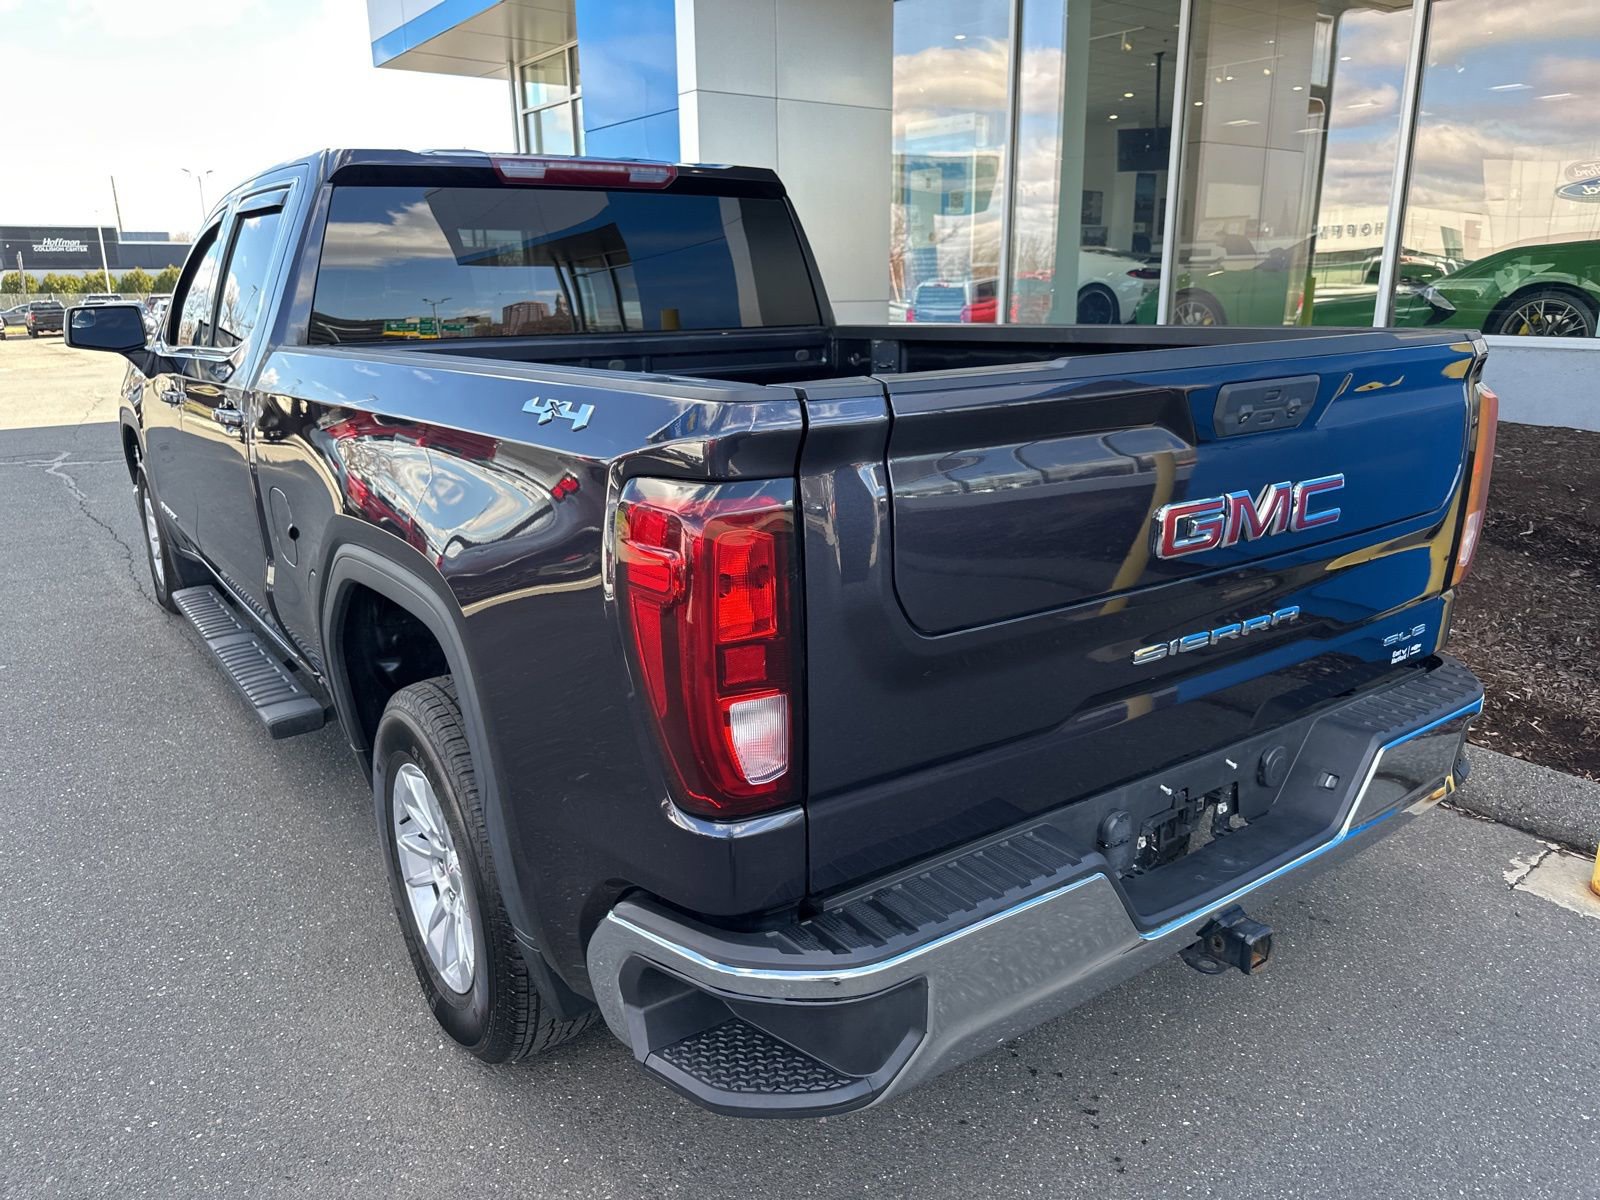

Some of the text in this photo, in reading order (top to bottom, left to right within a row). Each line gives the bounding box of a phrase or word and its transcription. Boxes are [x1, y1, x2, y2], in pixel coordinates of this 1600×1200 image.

[42, 237, 81, 247] Hoffman
[1153, 473, 1345, 560] GMC
[1130, 605, 1301, 665] SIERRA
